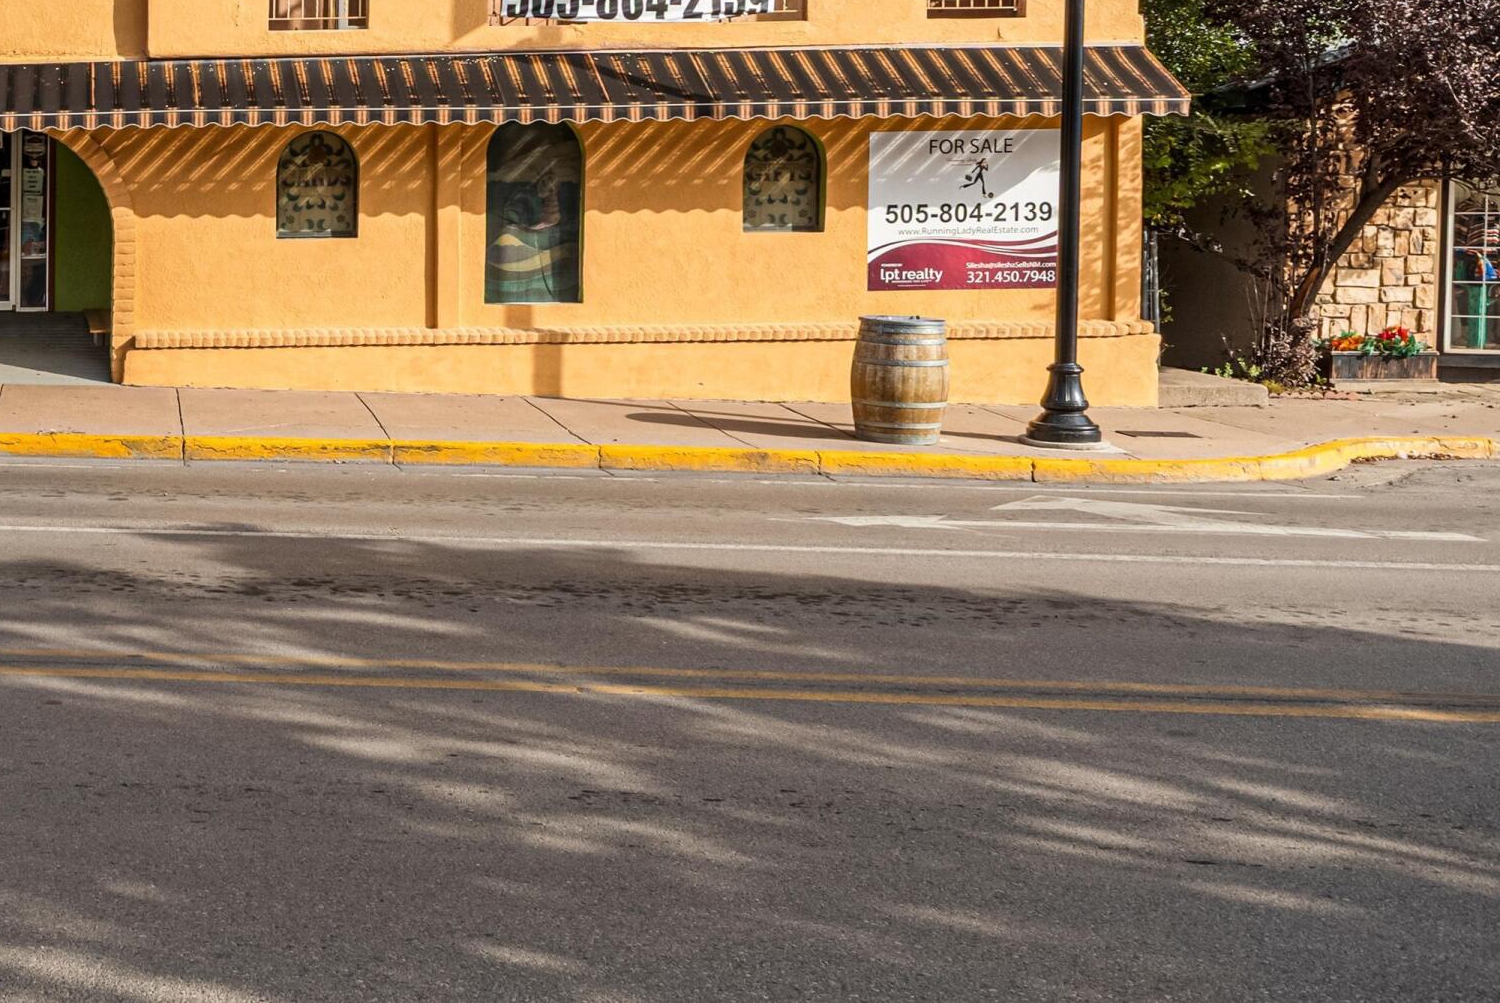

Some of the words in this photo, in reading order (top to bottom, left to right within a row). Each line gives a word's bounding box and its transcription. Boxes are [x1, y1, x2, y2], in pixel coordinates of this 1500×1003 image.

[928, 139, 964, 155] FOR
[970, 138, 1013, 154] SALE
[885, 202, 1053, 224] 505-804-2139
[898, 226, 1039, 236] www.RunningLadyRealEstate.com
[880, 268, 900, 283] lpt
[902, 268, 943, 283] realty
[966, 270, 1056, 283] 321.450.7948
